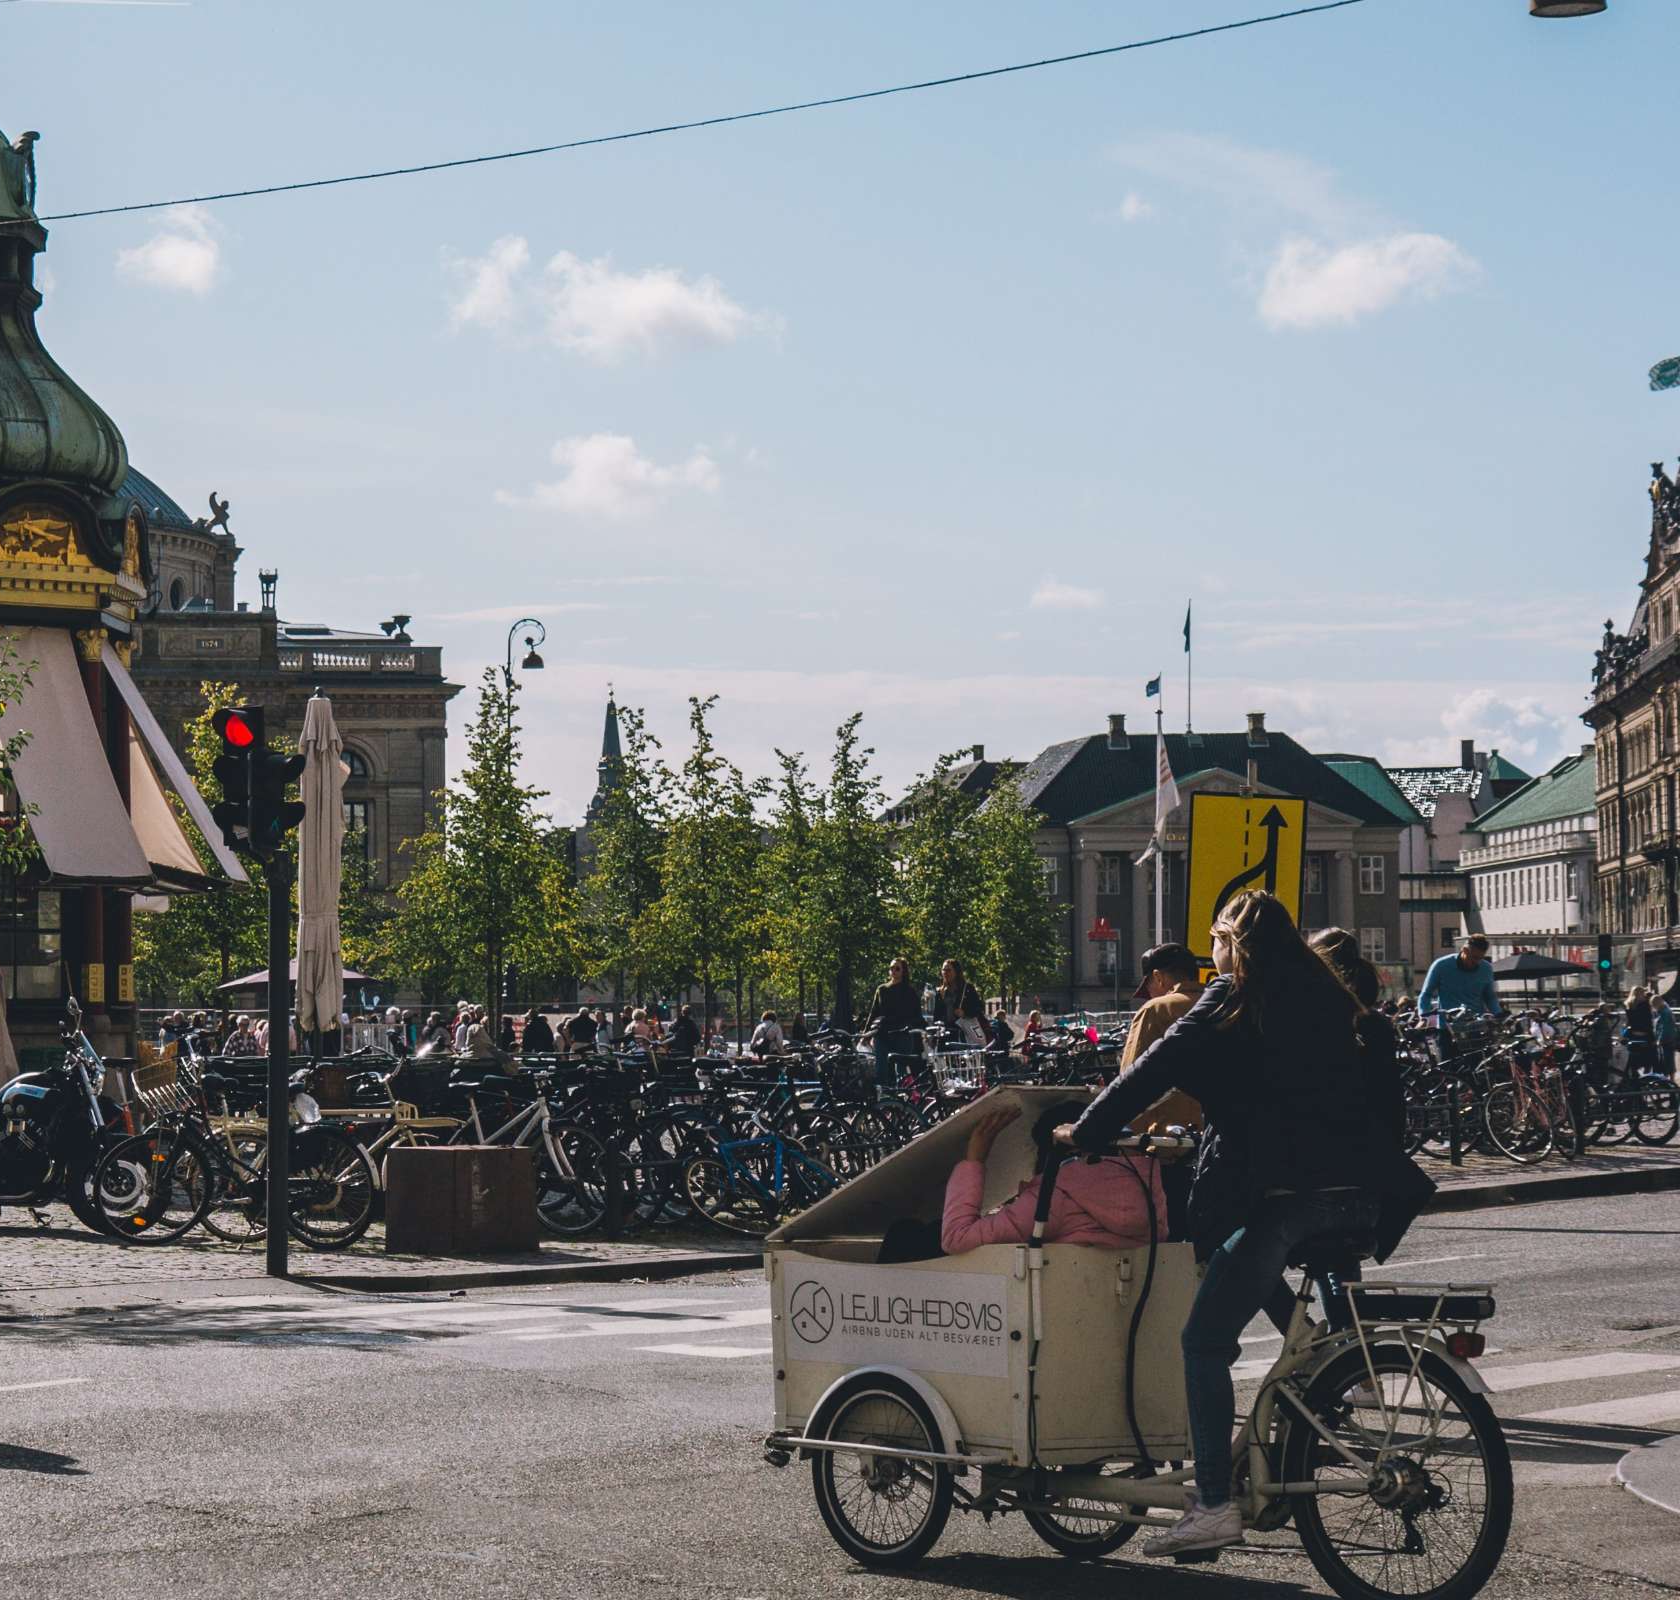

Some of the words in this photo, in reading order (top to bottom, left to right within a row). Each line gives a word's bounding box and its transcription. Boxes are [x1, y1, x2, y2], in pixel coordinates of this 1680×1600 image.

[841, 1293, 1002, 1332] LEJLIGHEDSVIS
[841, 1325, 880, 1336] AIRBNB
[885, 1328, 914, 1339] UDEN
[920, 1331, 939, 1341] ALT
[943, 1333, 1002, 1346] BESVÆRET
